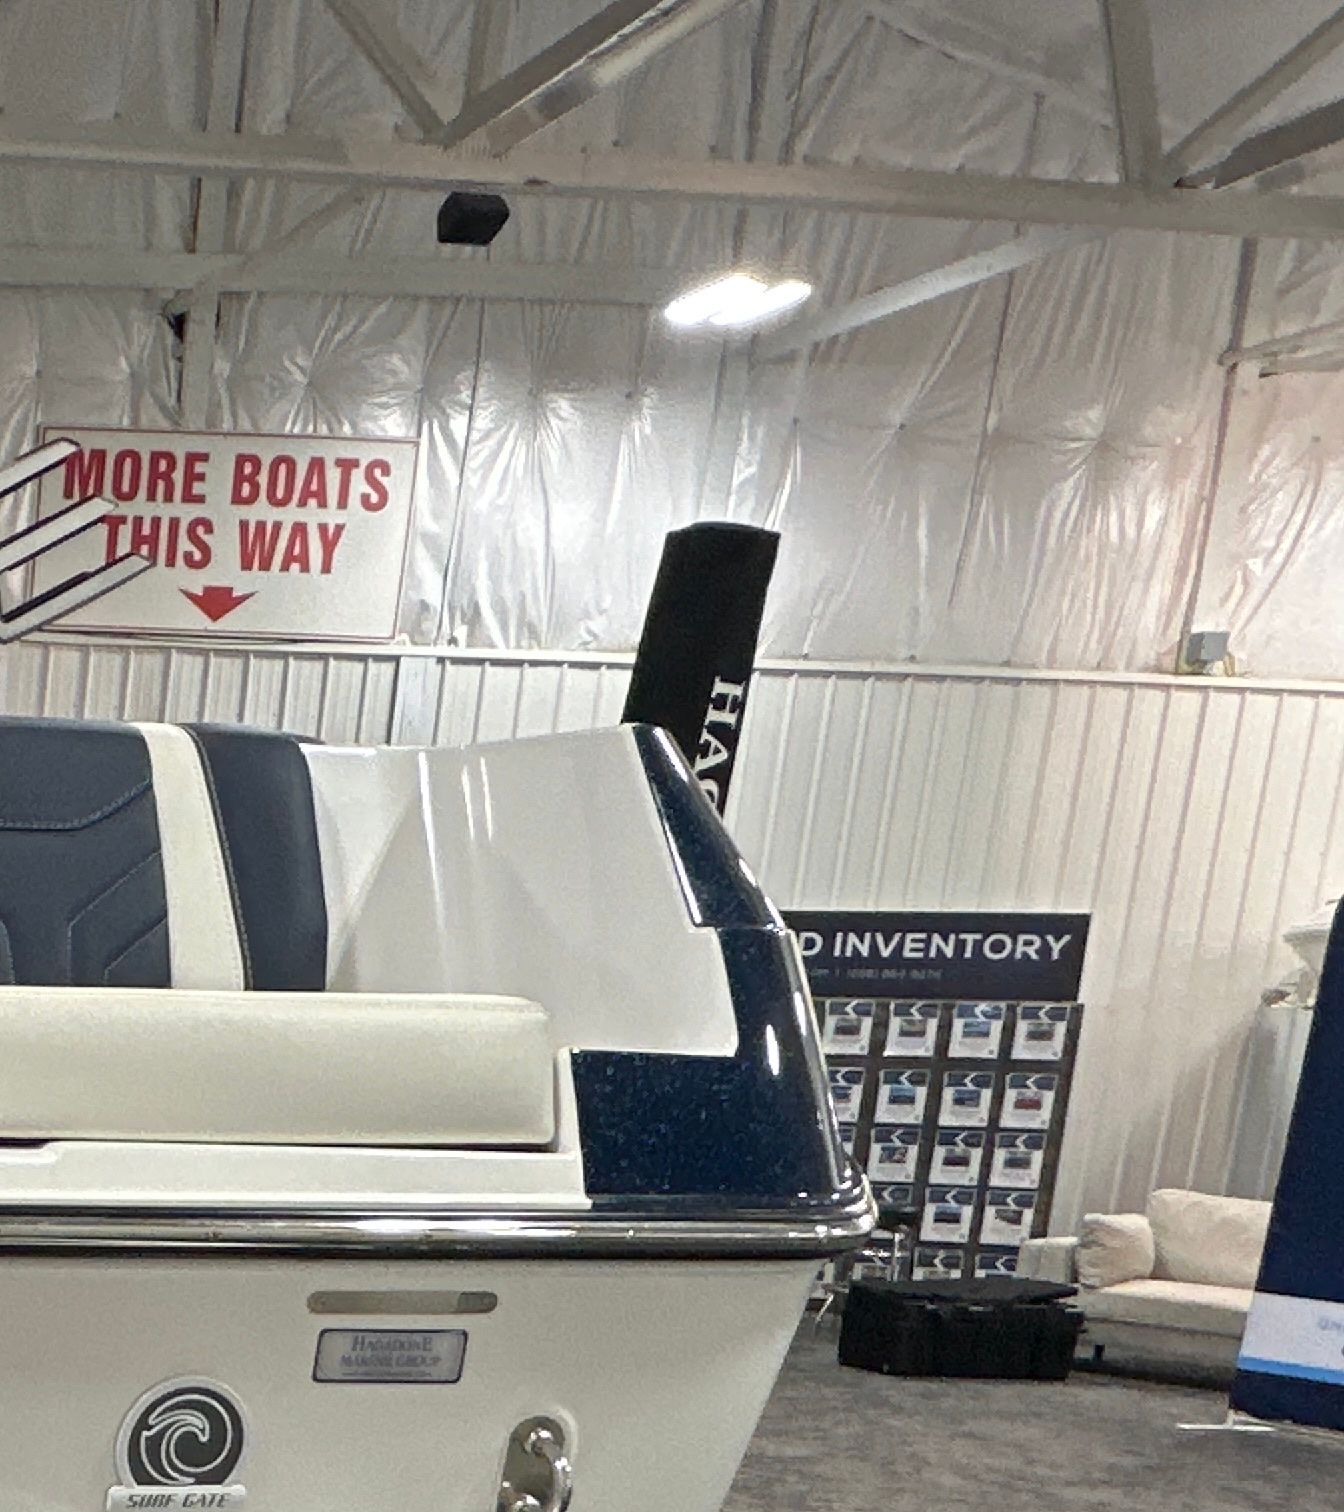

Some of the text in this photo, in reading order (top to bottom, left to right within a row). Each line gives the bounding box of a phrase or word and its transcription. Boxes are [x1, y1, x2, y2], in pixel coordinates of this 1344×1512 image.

[62, 448, 392, 512] MORE BOATS
[100, 514, 346, 574] THIS WAY
[832, 931, 1072, 961] INVENTORY
[126, 1492, 231, 1509] SURF GATE
